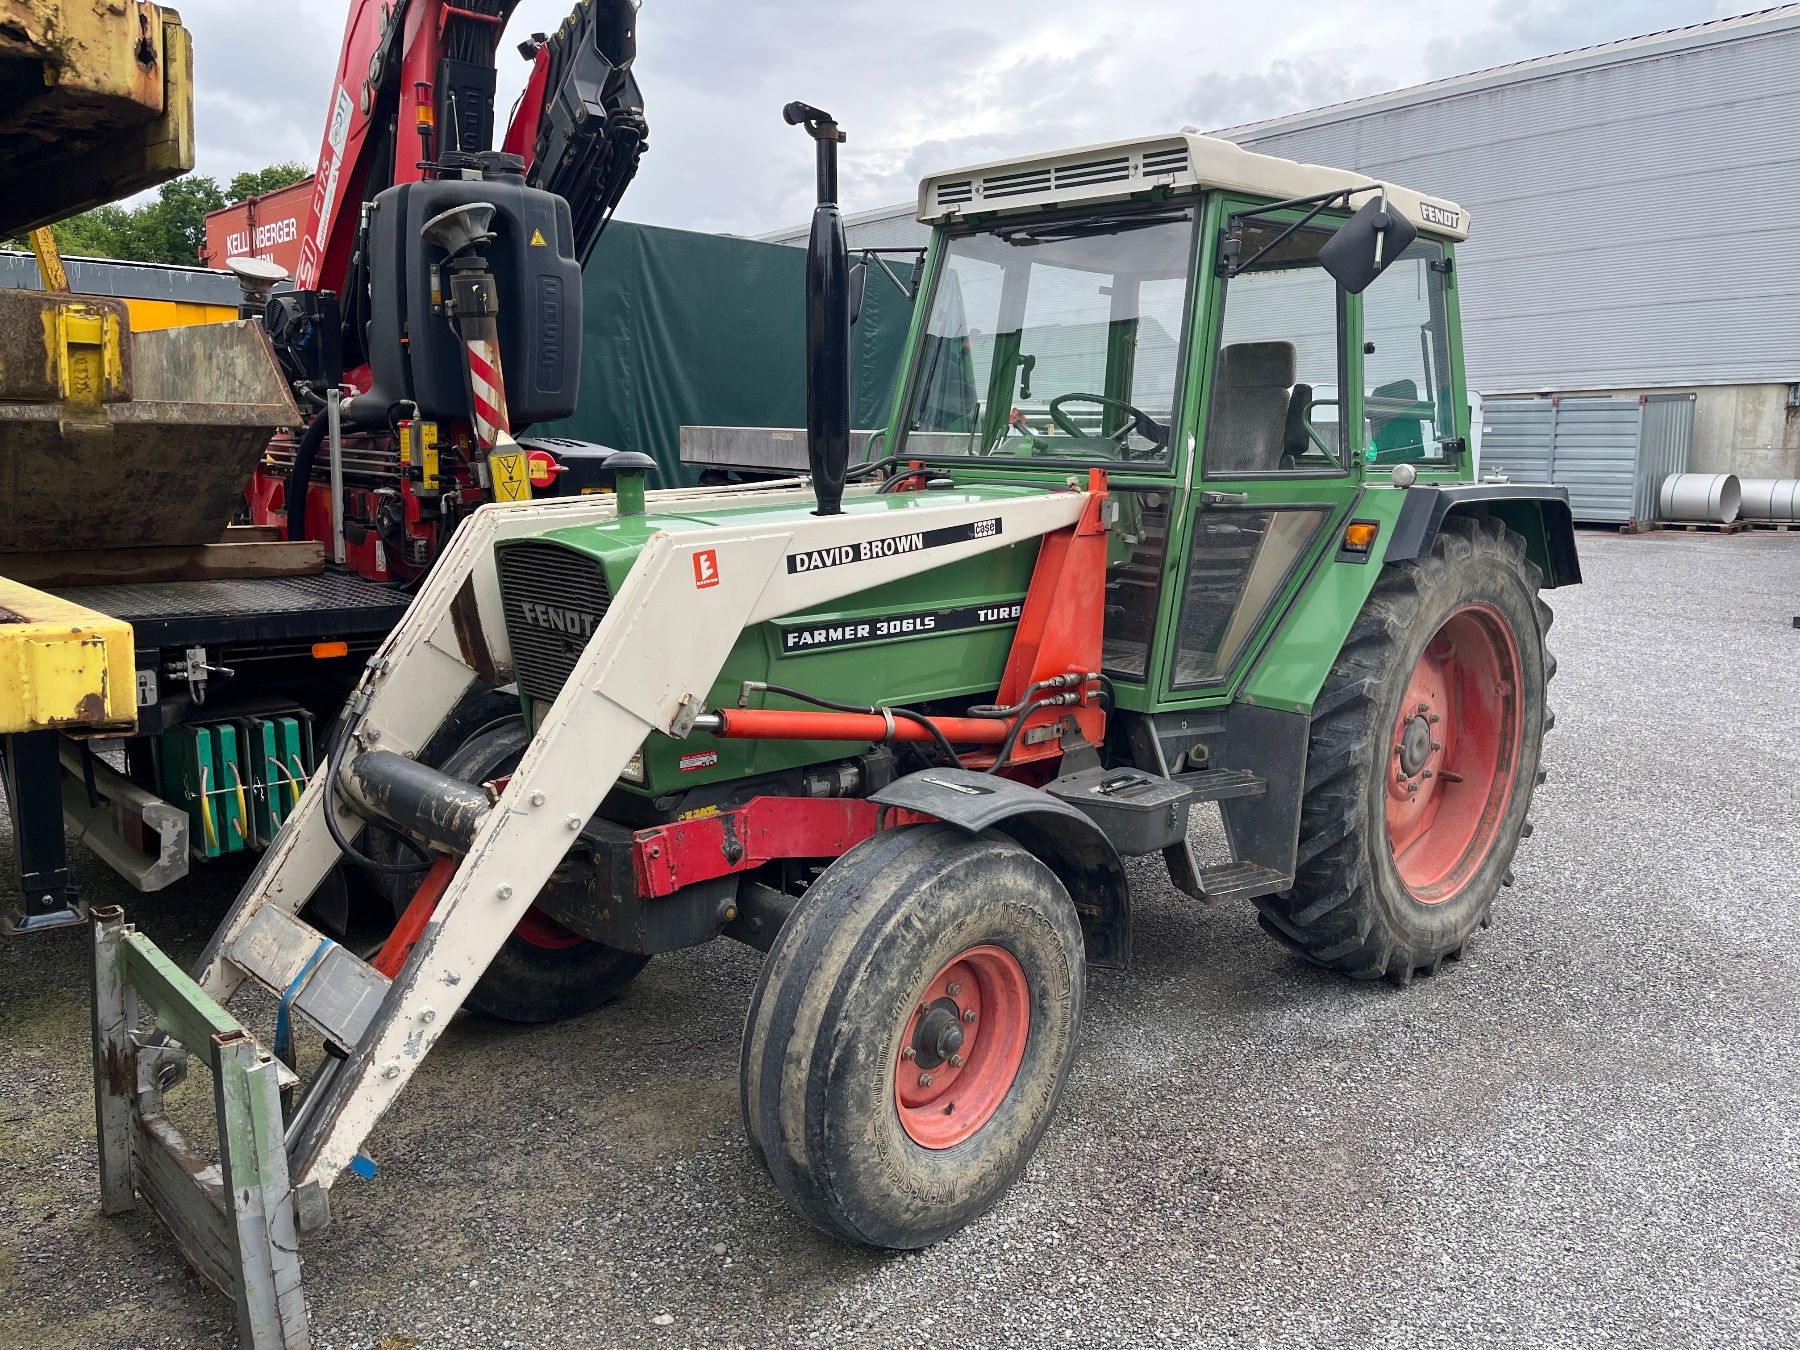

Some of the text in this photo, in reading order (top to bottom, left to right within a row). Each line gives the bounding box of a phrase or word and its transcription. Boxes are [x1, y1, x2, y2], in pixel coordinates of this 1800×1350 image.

[1420, 204, 1459, 228] FENDT
[226, 218, 297, 256] KELLNBERGER
[795, 546, 854, 572] DAVID
[860, 532, 923, 561] BROWN
[975, 522, 995, 536] case
[520, 601, 595, 637] FENDT
[787, 605, 1021, 647] FARMER 306LS TURB
